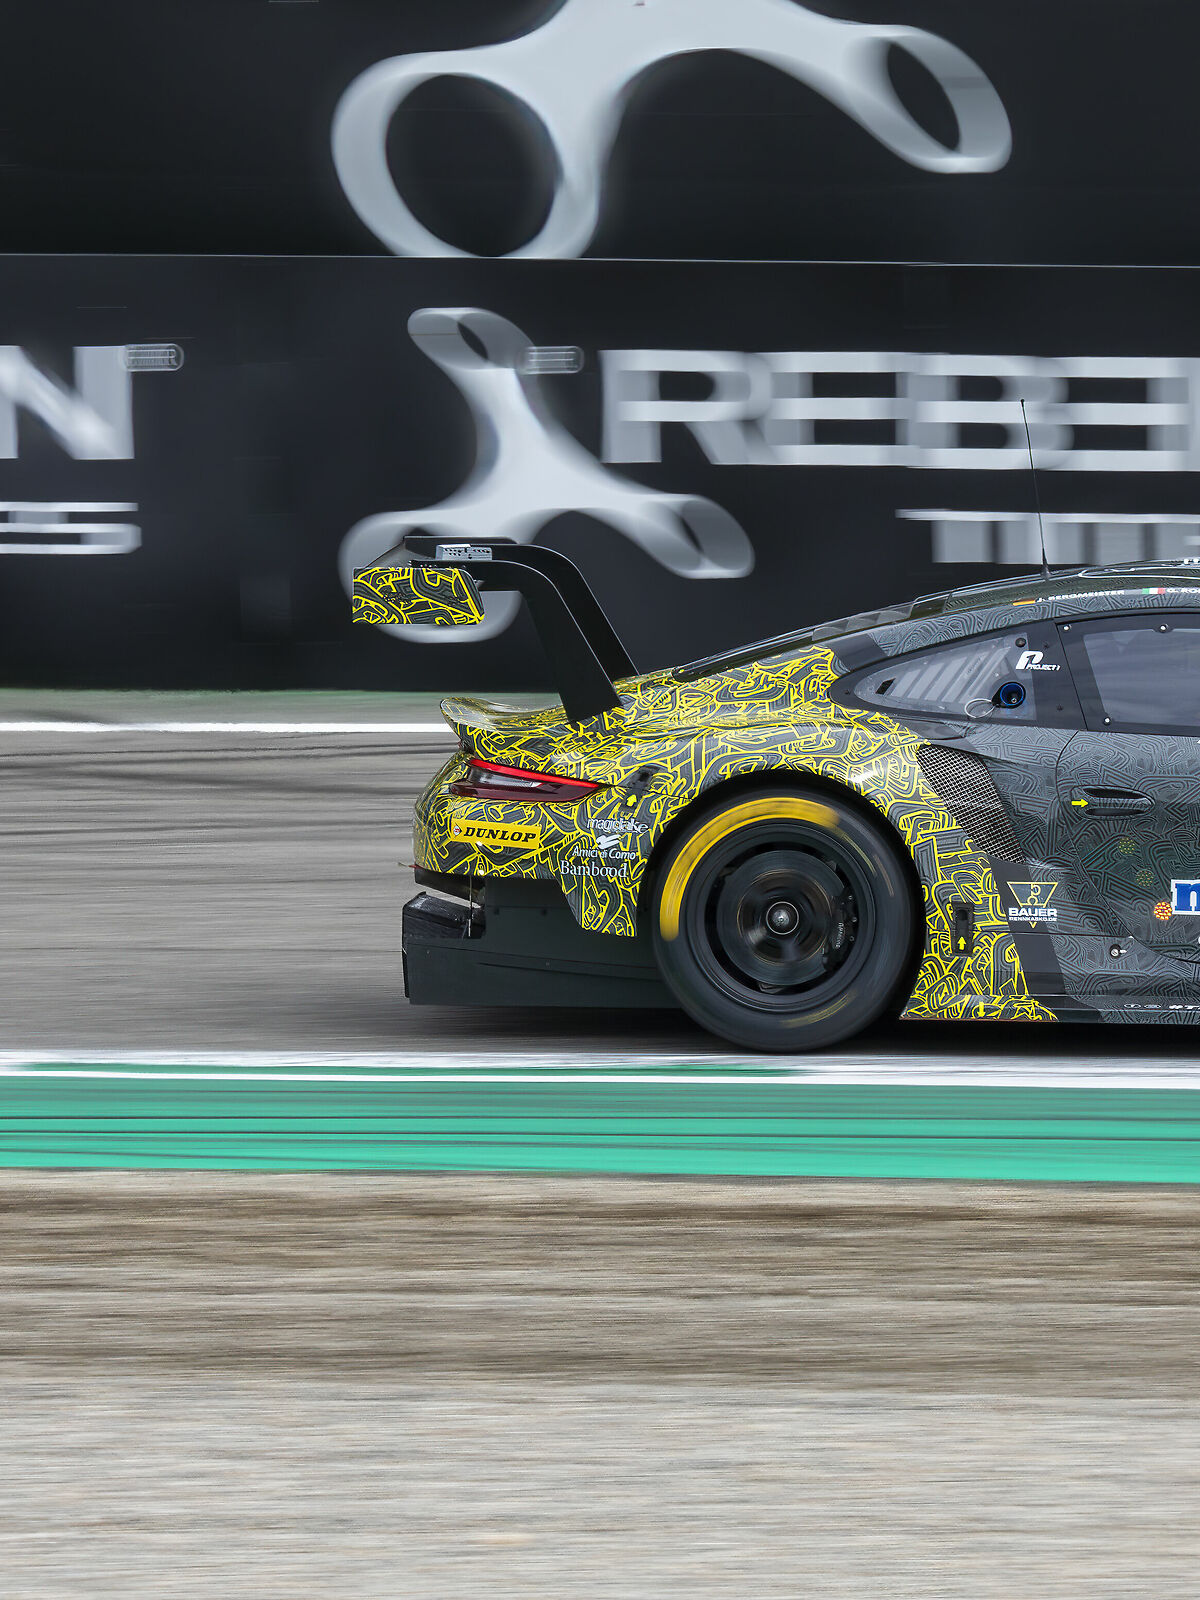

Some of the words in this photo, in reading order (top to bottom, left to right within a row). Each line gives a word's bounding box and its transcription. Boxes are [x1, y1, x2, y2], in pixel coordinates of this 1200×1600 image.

[463, 826, 537, 844] DUNLOP
[572, 845, 598, 858] Amici
[609, 848, 637, 860] Como
[1008, 907, 1058, 917] BAUER
